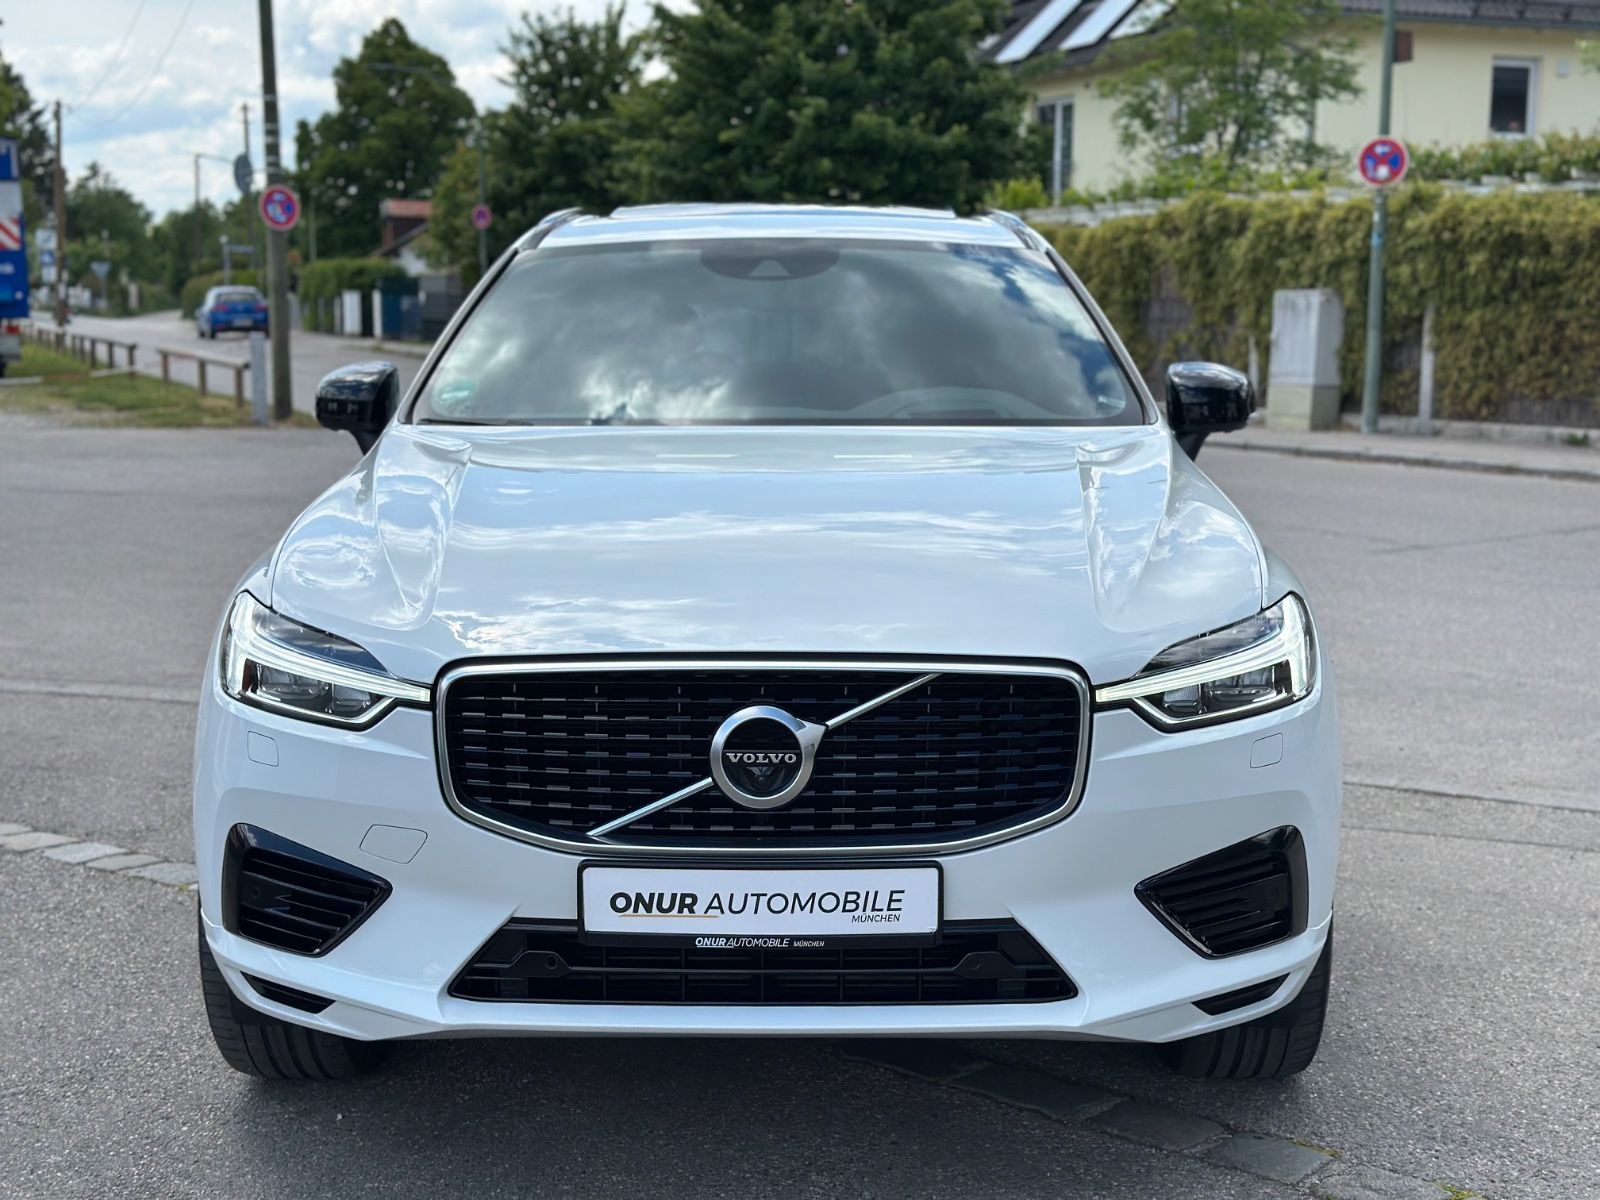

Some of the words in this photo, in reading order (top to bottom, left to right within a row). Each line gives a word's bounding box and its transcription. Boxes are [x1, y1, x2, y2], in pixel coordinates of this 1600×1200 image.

[725, 752, 797, 764] VOLVO
[609, 891, 698, 915] ONUR
[703, 889, 906, 915] AUTOMOBILE
[851, 912, 901, 924] MÜNCHEN
[695, 937, 727, 947] ONUR
[726, 937, 791, 948] AUTOMOBILE
[793, 940, 825, 948] MÜNCHEN
